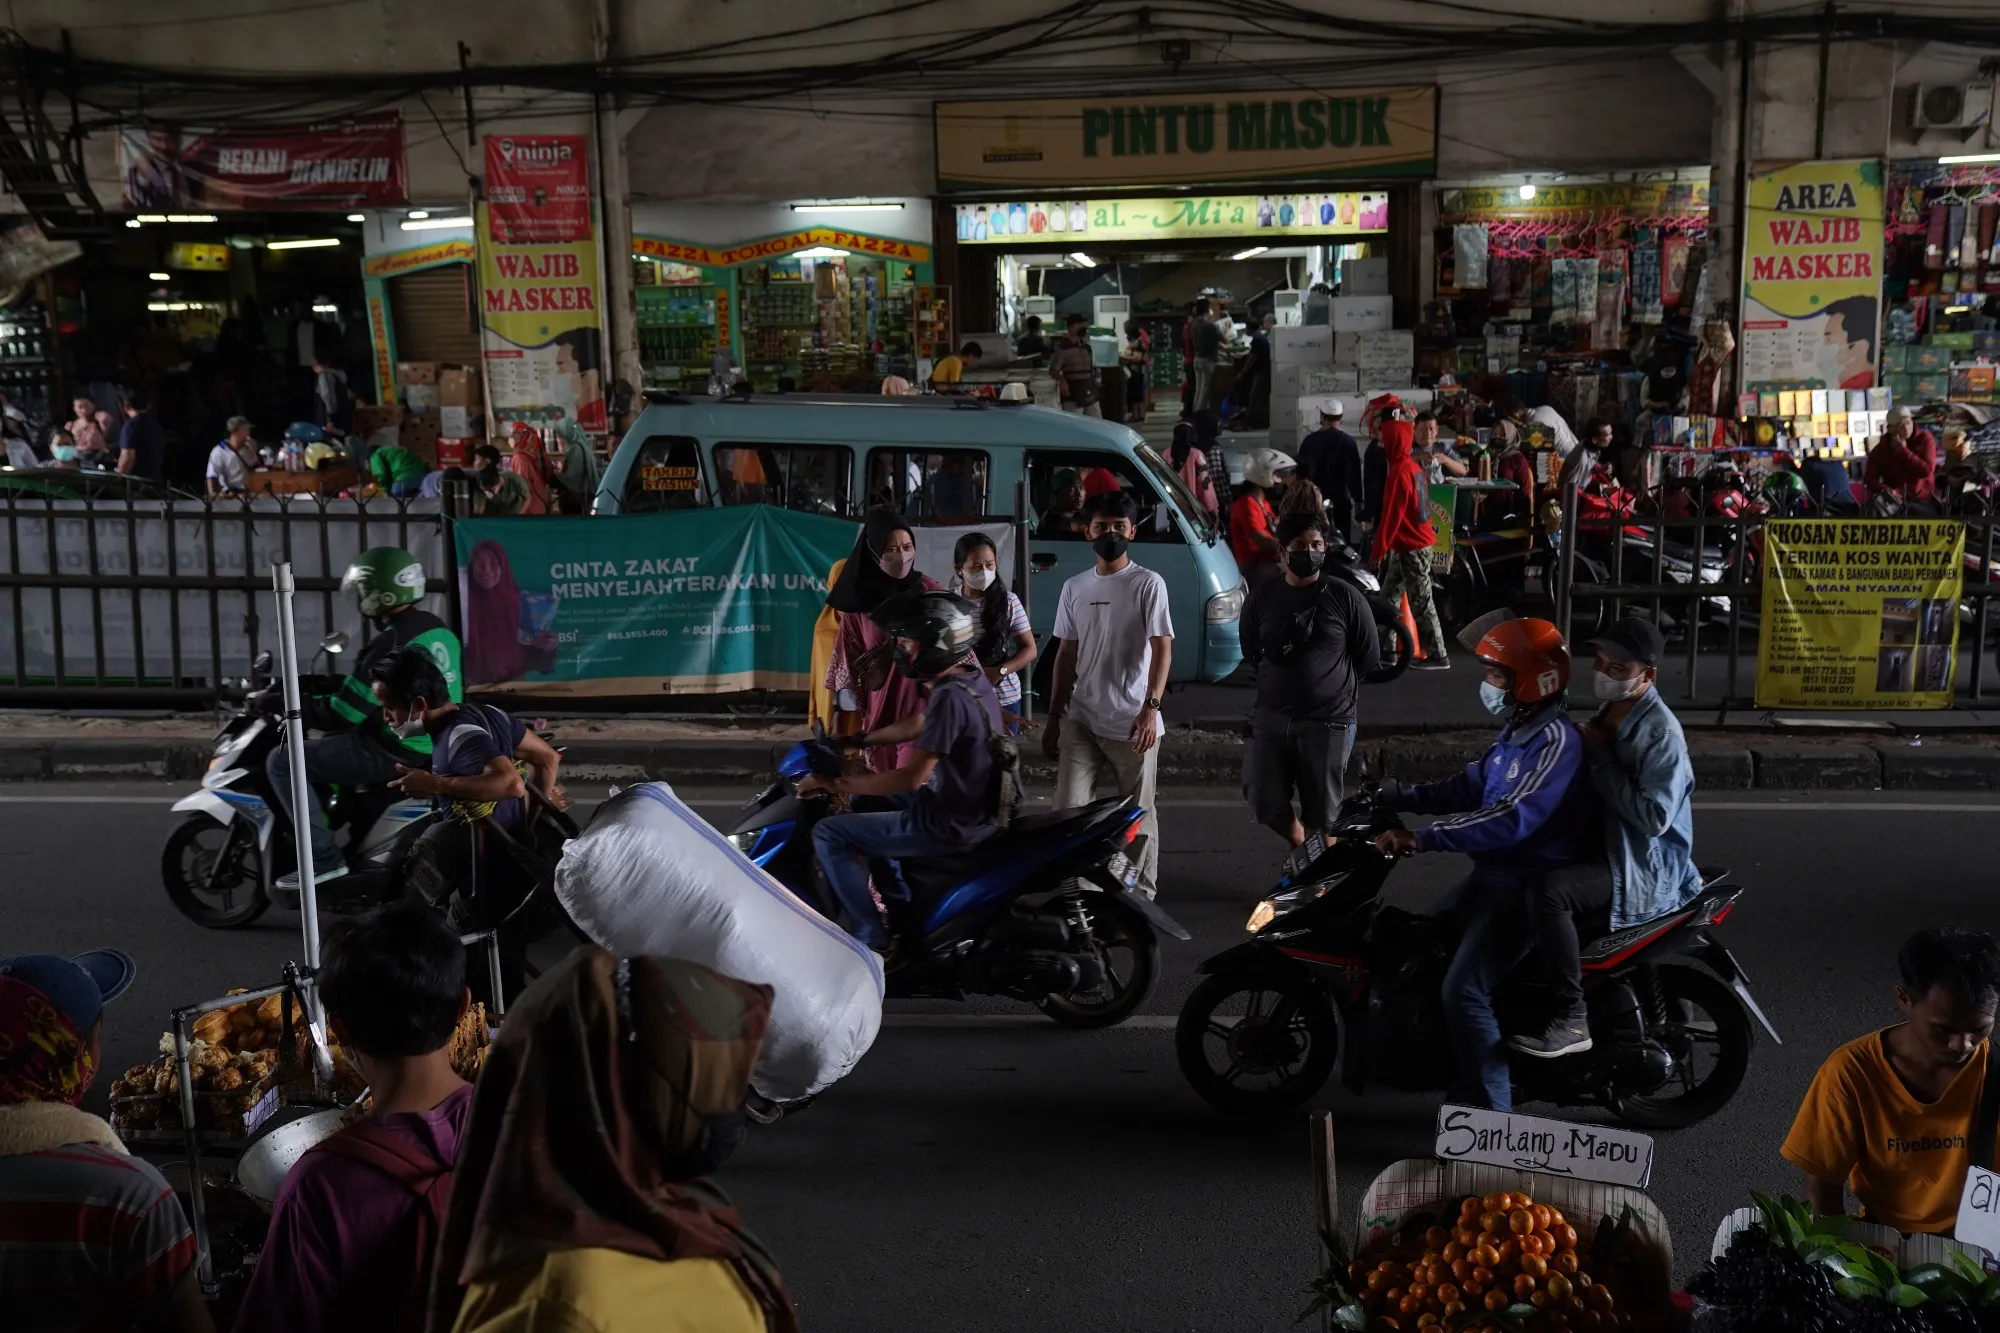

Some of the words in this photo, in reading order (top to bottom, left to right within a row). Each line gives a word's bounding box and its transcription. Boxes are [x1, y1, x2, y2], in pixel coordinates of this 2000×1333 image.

[1082, 103, 1215, 158] PINTU
[1227, 97, 1393, 153] MASUK
[217, 148, 288, 175] BERANI
[516, 140, 573, 166] ninja
[1774, 182, 1857, 210] AREA
[1768, 218, 1861, 246] WAJIB
[720, 238, 788, 265] TOKO
[495, 253, 581, 279] WAJIB
[1751, 253, 1873, 281] MASKER
[484, 286, 595, 313] MASKER
[1839, 523, 1931, 545] SEMBILAN
[550, 560, 618, 580] CINTA
[624, 556, 700, 576] ZAKAT
[1777, 551, 1841, 565] TERIMA
[1845, 551, 1881, 565] KOS
[1886, 550, 1952, 565] WANITA
[551, 573, 778, 600] MENYEJAHTERAKAN
[783, 574, 829, 593] UMA
[1769, 567, 1807, 581] FAILITAS
[1809, 567, 1837, 581] KAMAR
[1838, 568, 1844, 580] &
[1847, 568, 1891, 581] BANGUNAN
[1893, 568, 1914, 581] BARU
[1804, 584, 1850, 593] AMAN
[1856, 584, 1923, 593] NYAMAN
[558, 631, 577, 643] BSI
[1887, 1134, 1966, 1153] FiveBooth
